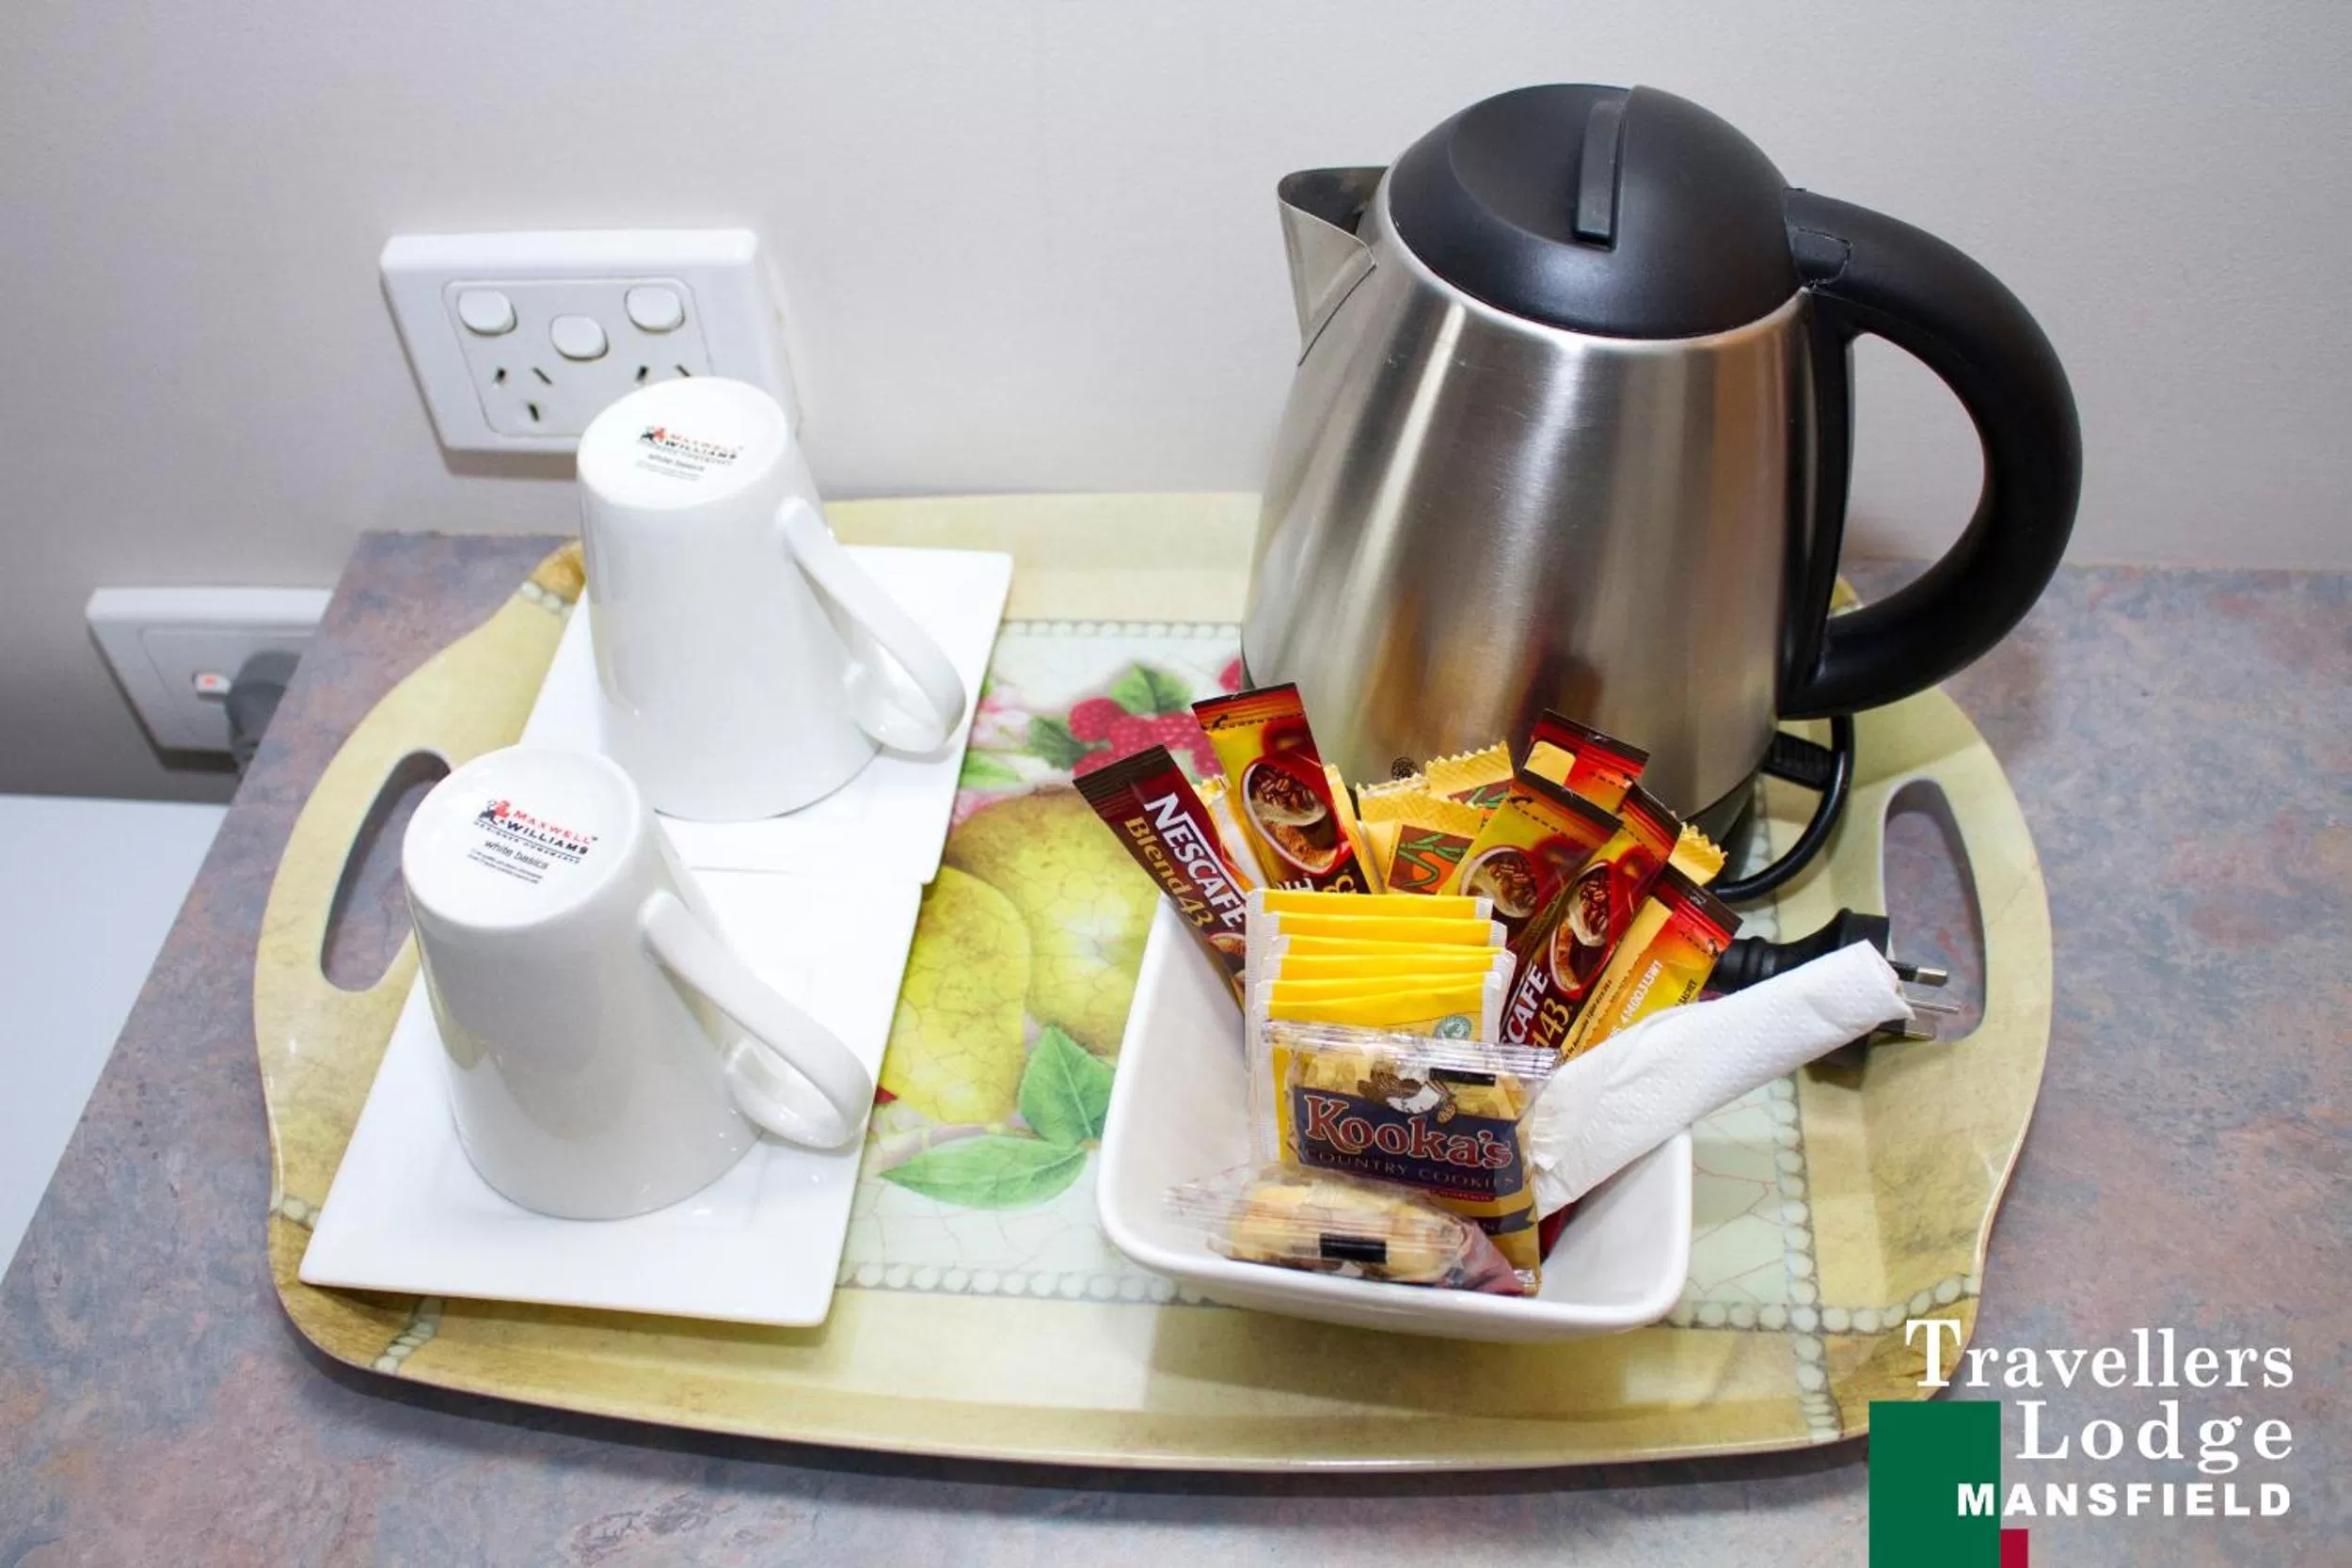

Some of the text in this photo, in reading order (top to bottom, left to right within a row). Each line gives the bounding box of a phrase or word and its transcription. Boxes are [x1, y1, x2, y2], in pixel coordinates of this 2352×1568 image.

[484, 840, 514, 858] white
[514, 850, 550, 870] basics
[513, 810, 591, 845] MAXWELL
[1125, 816, 1216, 928] Blend 43
[1507, 964, 1549, 1044] CAFE
[1304, 1094, 1515, 1169] Kooka's
[1306, 1147, 1407, 1176] COUNTRY
